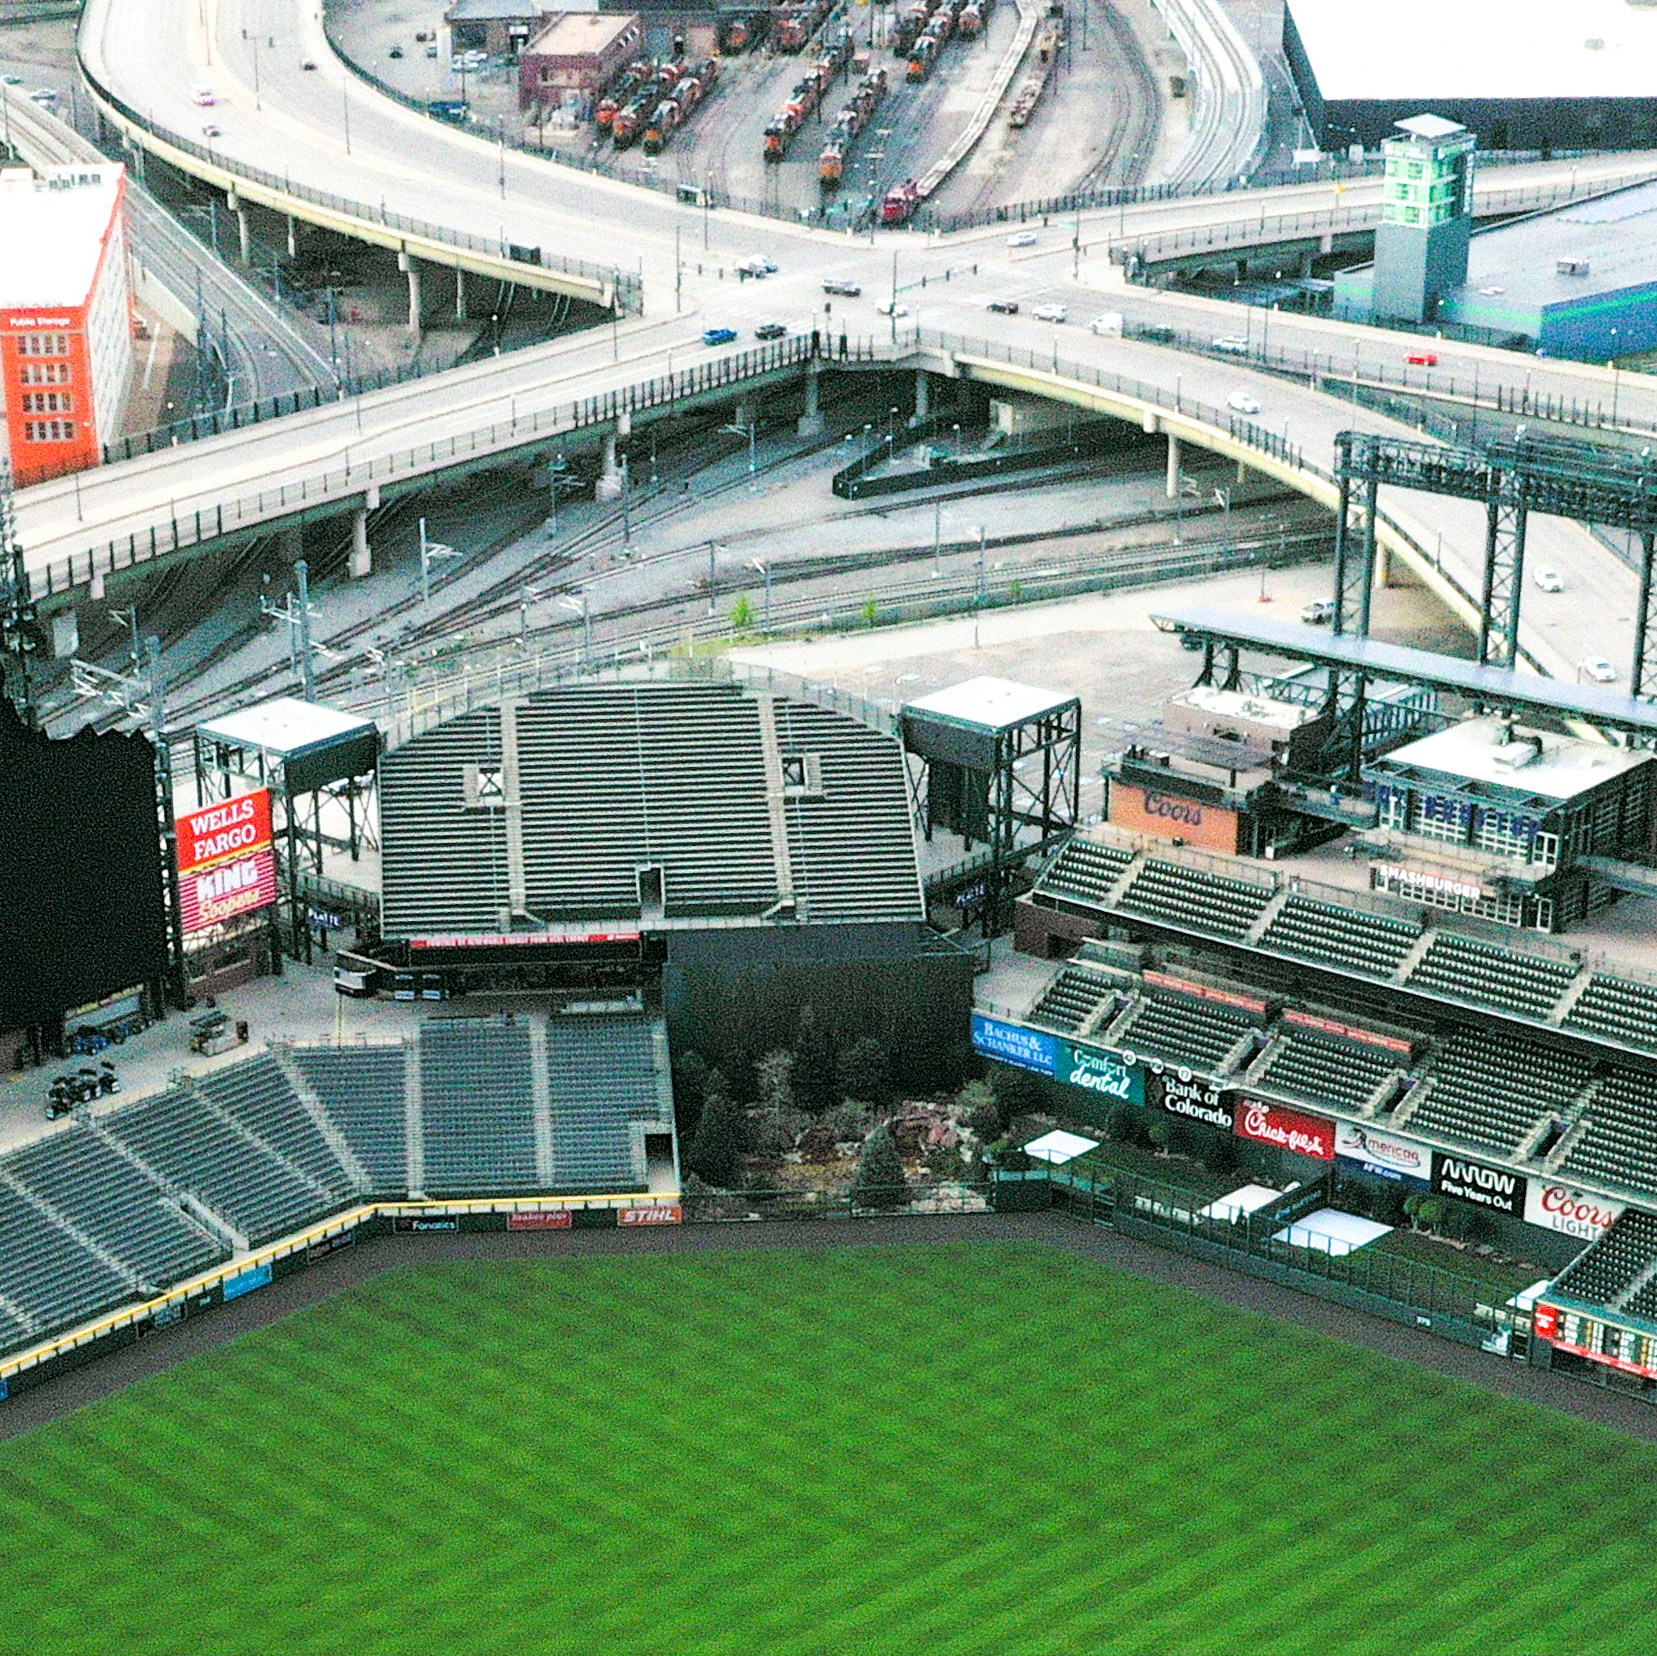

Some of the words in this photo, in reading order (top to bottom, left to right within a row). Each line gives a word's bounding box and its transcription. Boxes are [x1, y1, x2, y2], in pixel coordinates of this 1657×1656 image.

[190, 799, 255, 836] WELLS
[1144, 792, 1202, 825] Coors
[193, 824, 256, 860] FARGO
[196, 859, 259, 901] KING
[1379, 864, 1481, 900] SMASHBURGER
[1029, 1036, 1043, 1051] &
[1069, 1066, 1131, 1099] dental
[1165, 1077, 1202, 1103] Bank
[1204, 1090, 1220, 1106] of
[1164, 1094, 1233, 1127] Colorado
[1245, 1105, 1325, 1155] Chick-fil-A
[1441, 1158, 1516, 1195] ARROW
[1441, 1180, 1463, 1196] Five
[1463, 1186, 1492, 1205] Years
[1492, 1195, 1513, 1212] Out
[1541, 1186, 1614, 1228] Coors
[623, 1209, 676, 1223] STIHL
[1552, 1214, 1600, 1239] LIGHT
